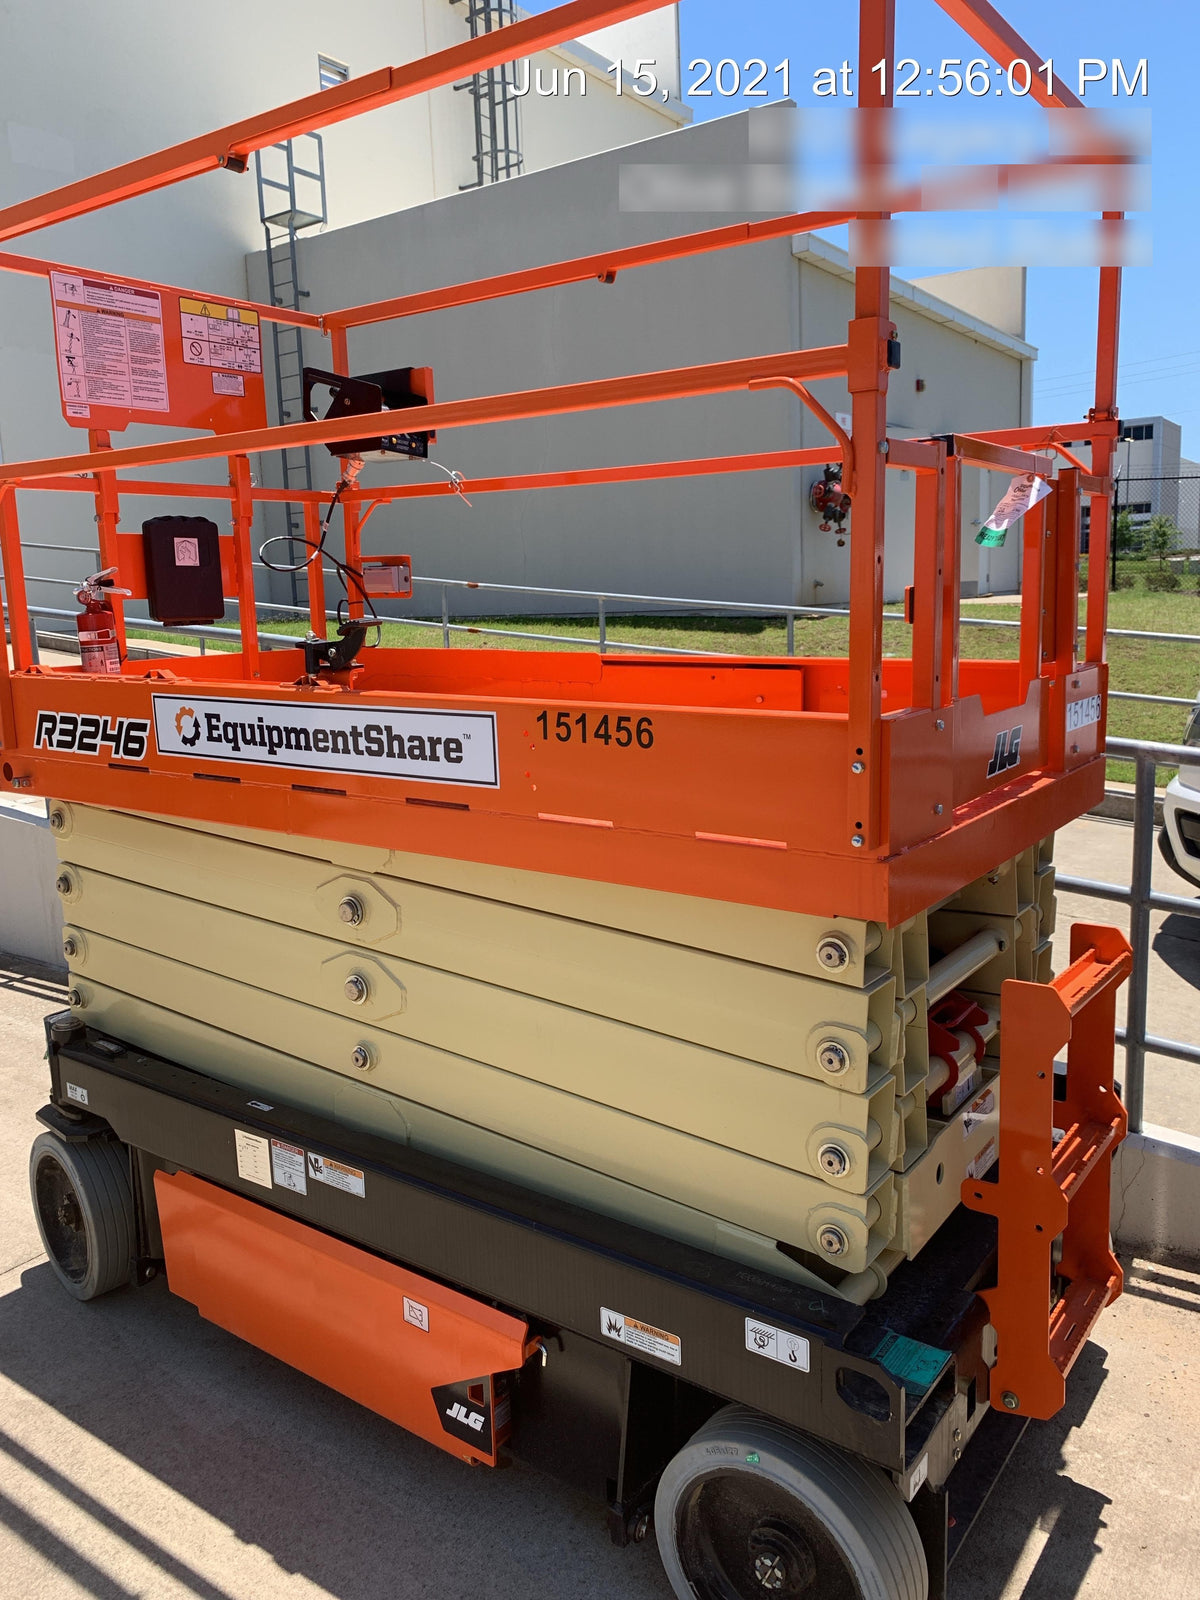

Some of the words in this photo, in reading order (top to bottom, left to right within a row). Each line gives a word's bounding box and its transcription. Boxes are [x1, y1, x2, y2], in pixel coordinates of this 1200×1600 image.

[114, 286, 136, 295] DANGER
[102, 308, 125, 318] WARNING
[536, 709, 655, 749] 151456
[1067, 694, 1101, 729] 151456
[33, 709, 151, 761] R3246
[204, 712, 464, 764] EquipmentShare
[986, 725, 1023, 779] JLG
[640, 1325, 669, 1341] WARNING
[445, 1401, 486, 1432] JLG
